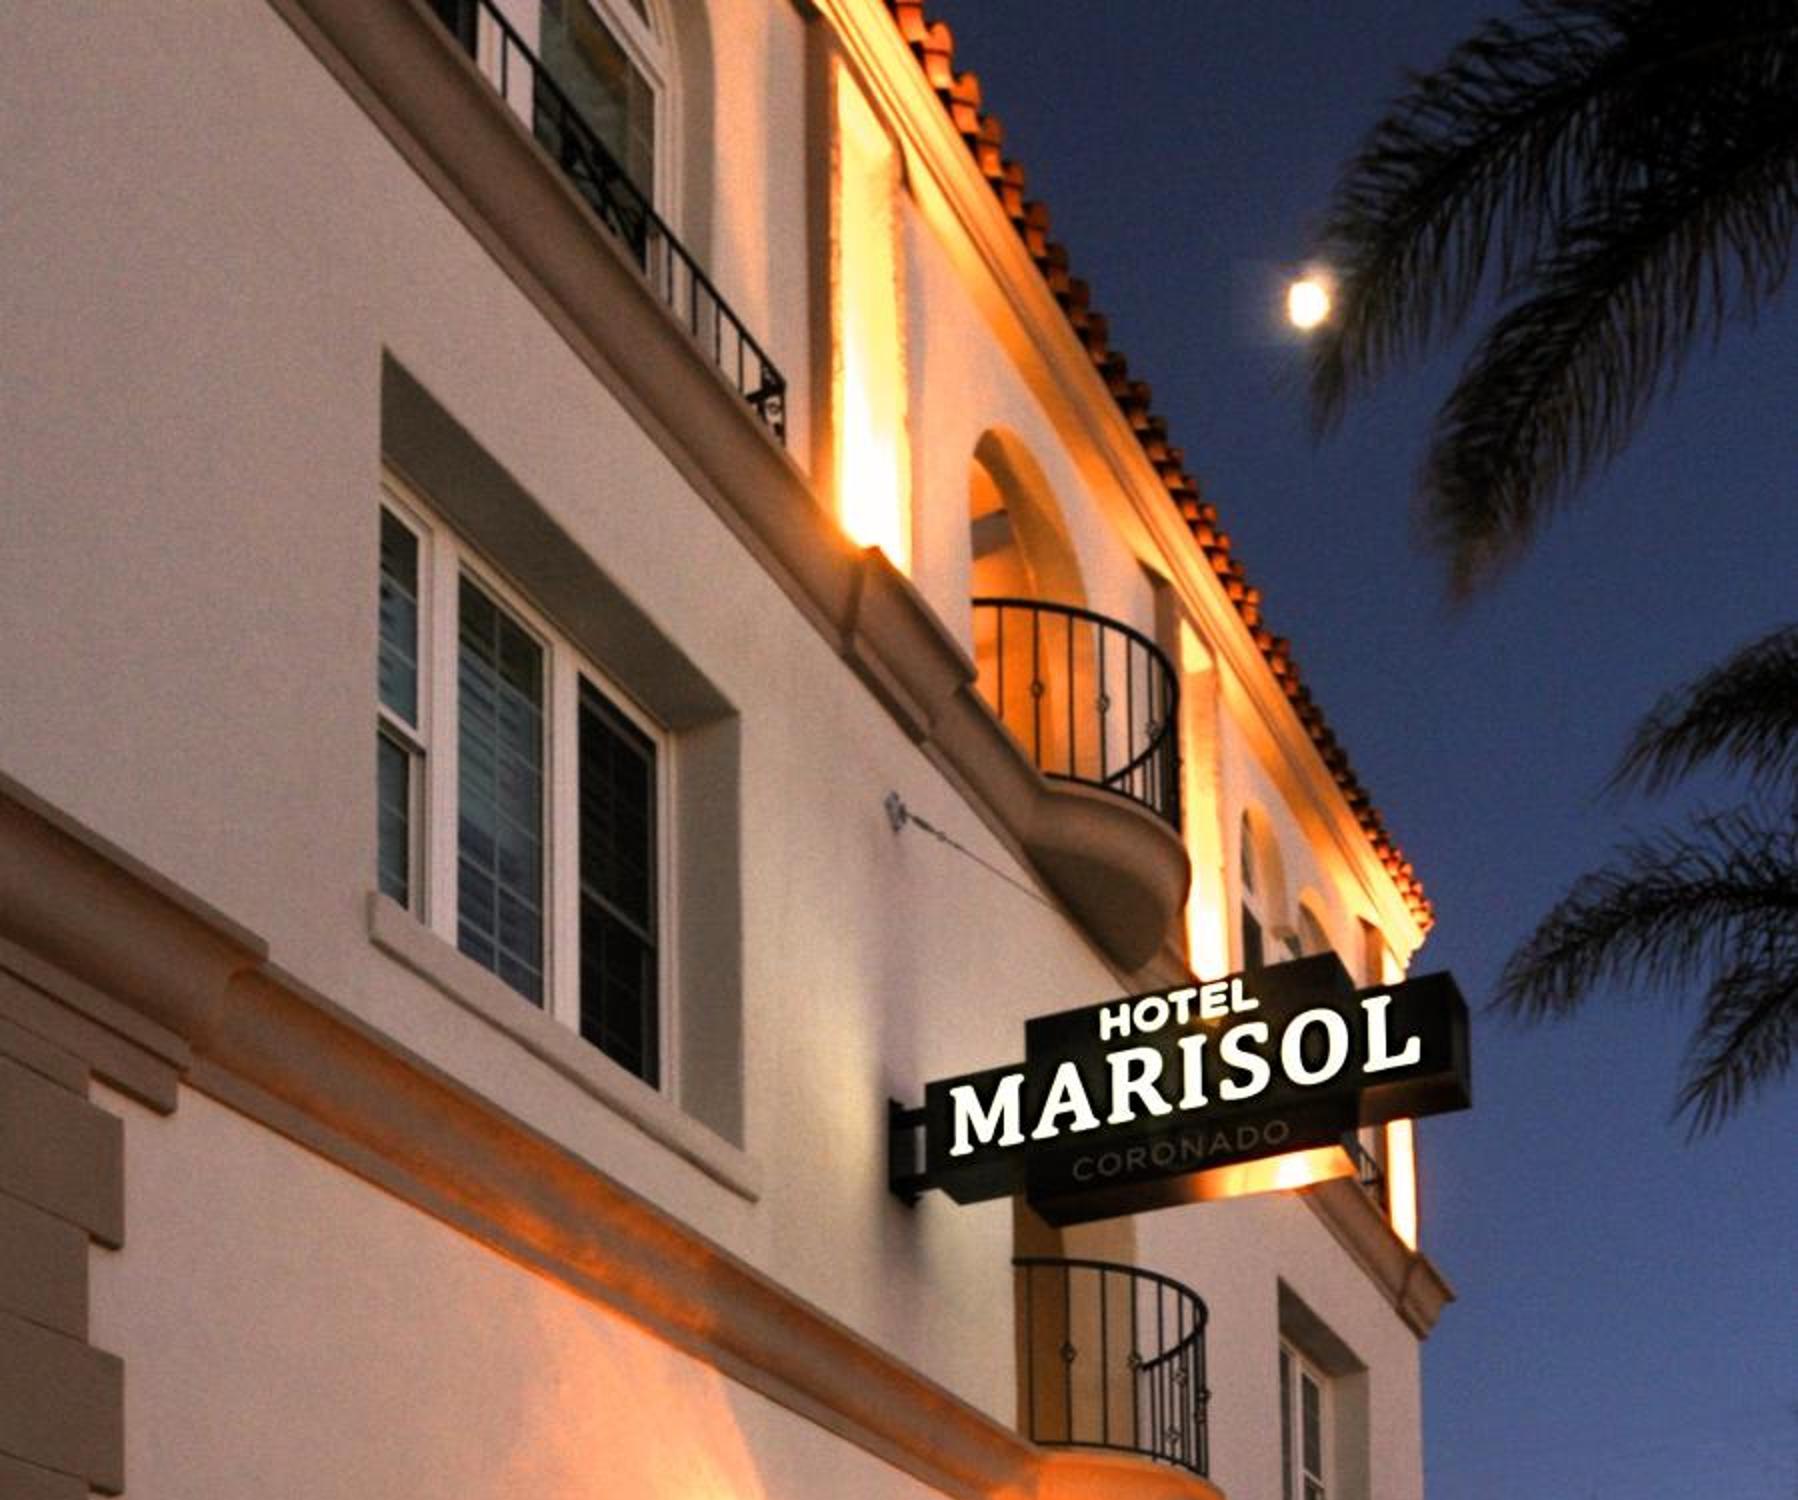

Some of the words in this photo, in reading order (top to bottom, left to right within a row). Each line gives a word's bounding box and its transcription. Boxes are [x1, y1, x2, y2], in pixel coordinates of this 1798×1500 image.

[1100, 978, 1260, 1042] HOTEL
[949, 994, 1422, 1157] MARISOL
[1072, 1120, 1290, 1183] CORONADO
